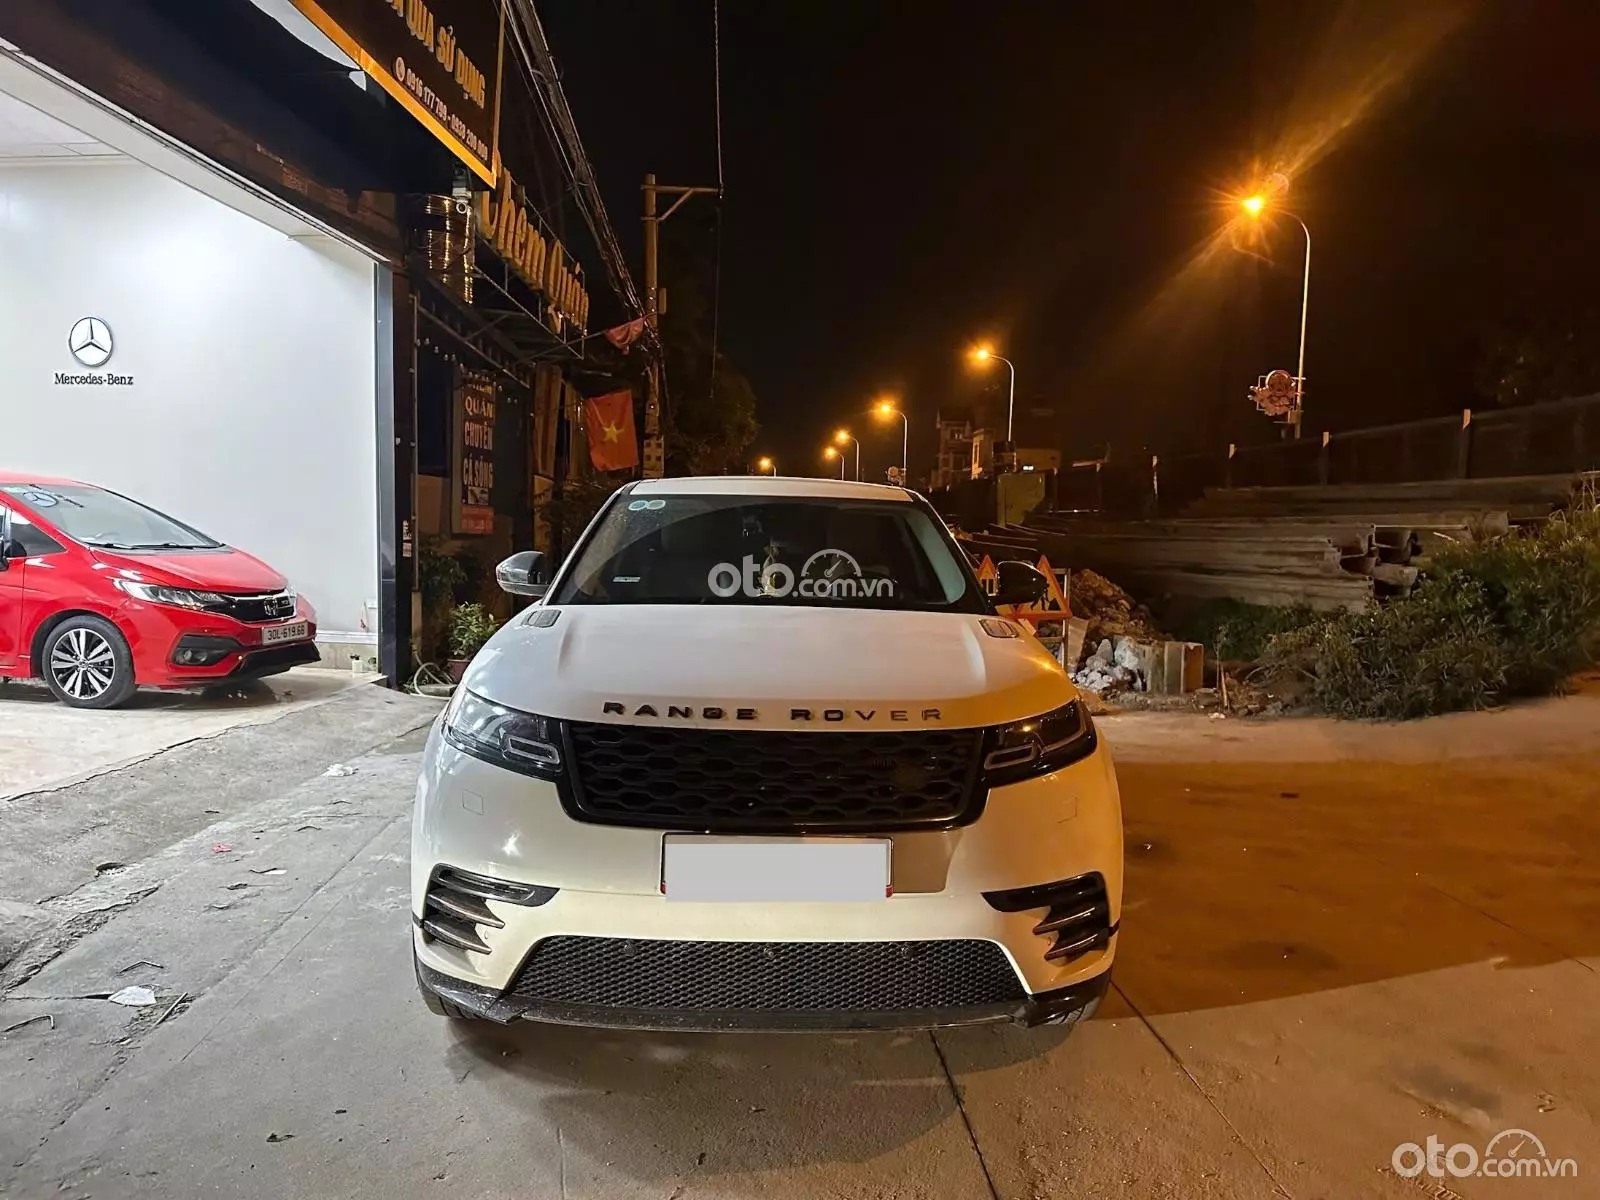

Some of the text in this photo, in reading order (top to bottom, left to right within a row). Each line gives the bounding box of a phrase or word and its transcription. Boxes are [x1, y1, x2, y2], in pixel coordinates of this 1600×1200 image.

[436, 25, 456, 73] SỬ
[455, 47, 486, 109] DỤNG
[54, 372, 134, 385] Mercedes-Benz
[602, 701, 943, 722] RANGE ROVER
